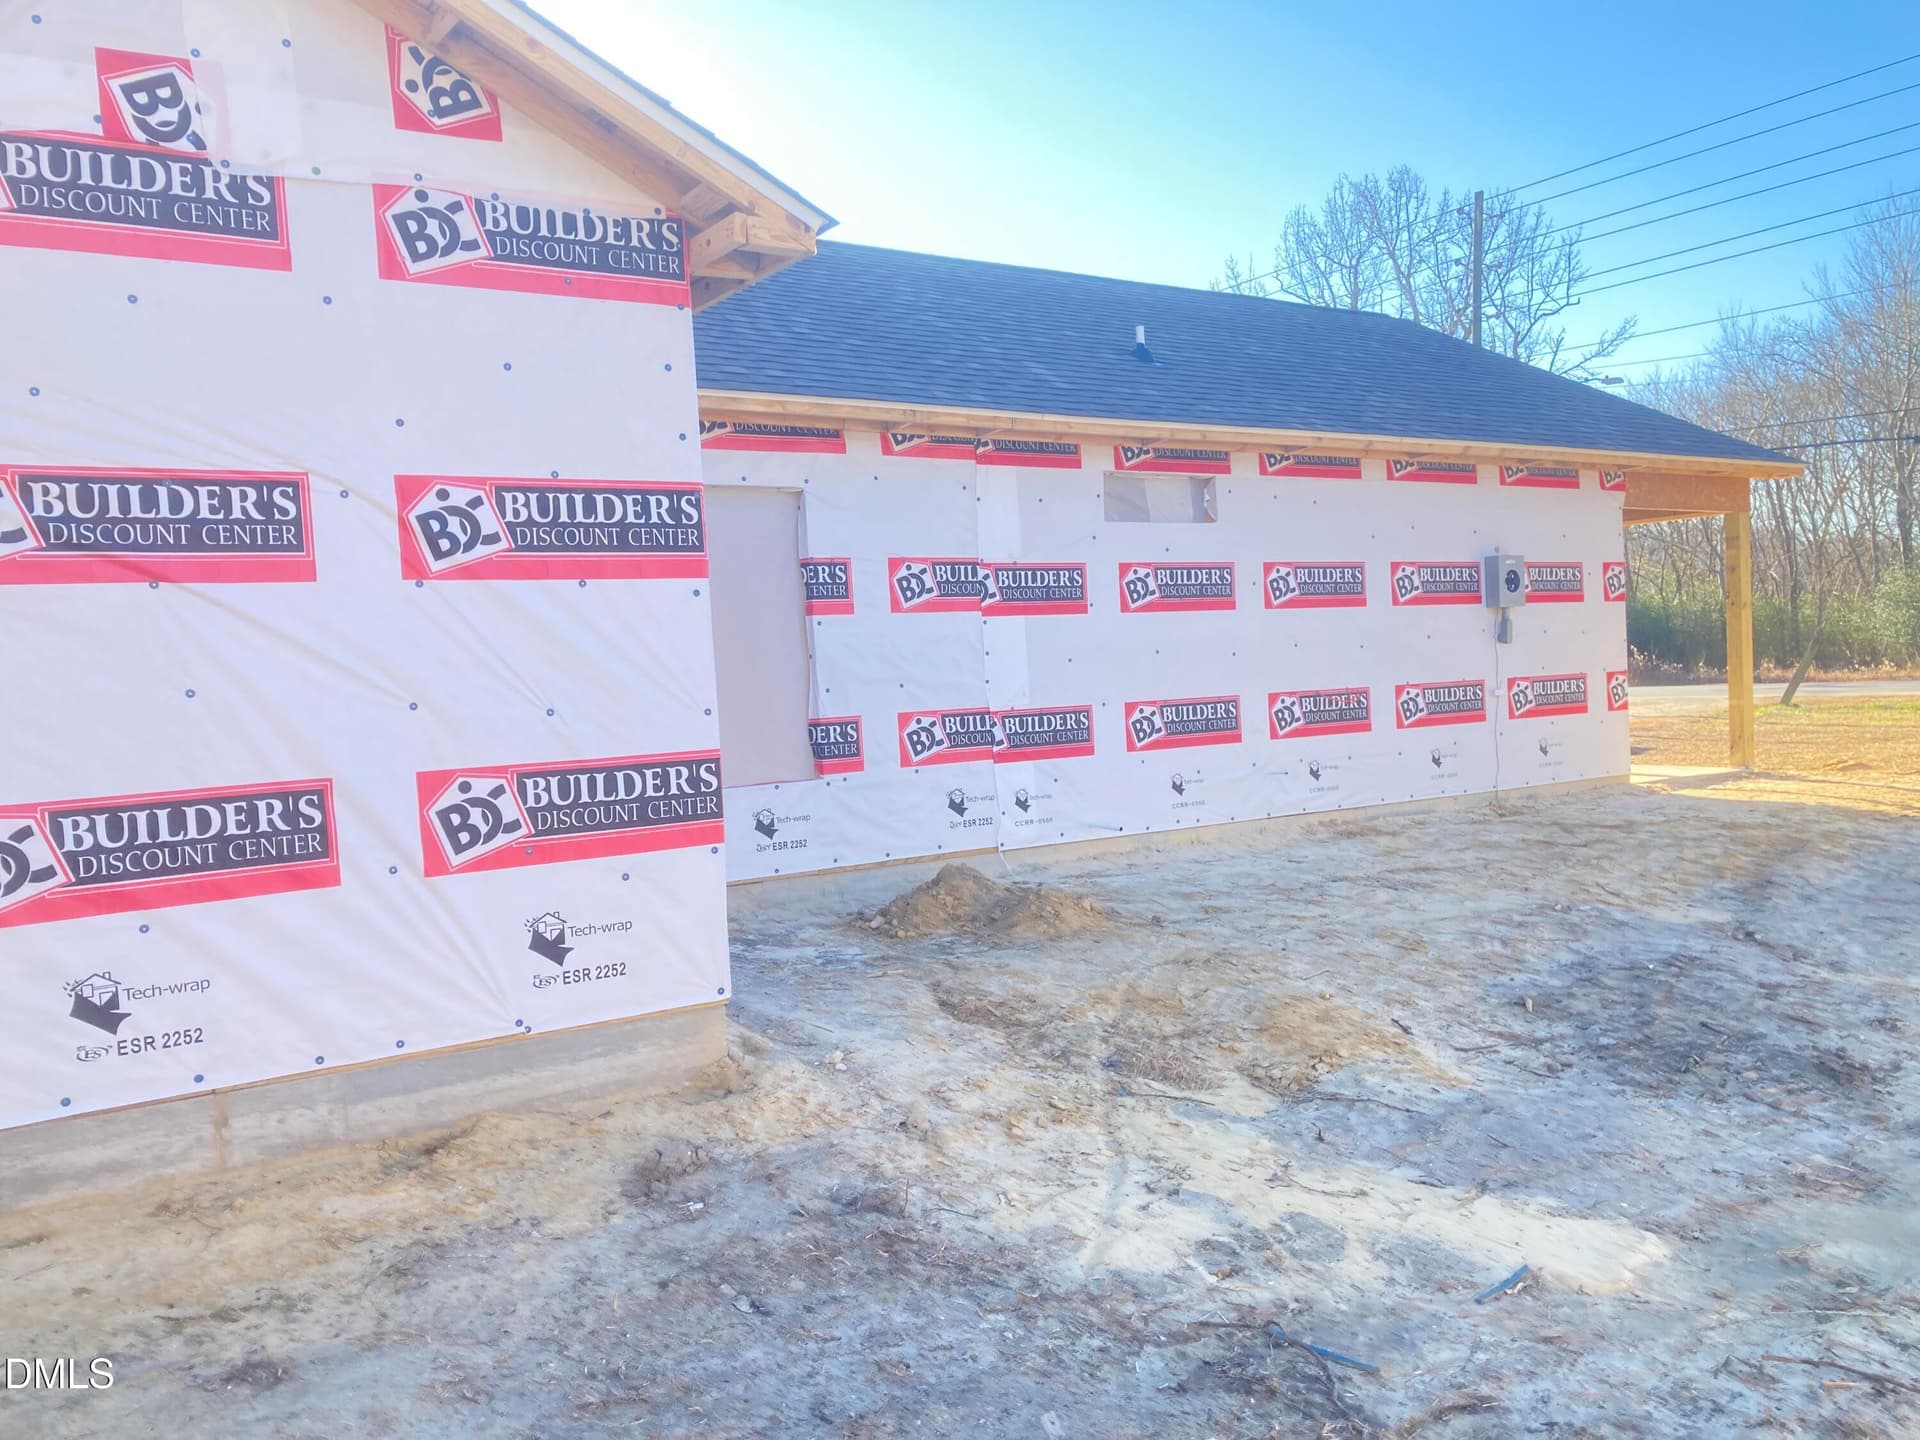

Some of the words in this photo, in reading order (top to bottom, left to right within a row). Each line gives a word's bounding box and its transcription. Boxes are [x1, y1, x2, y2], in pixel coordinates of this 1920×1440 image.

[1, 141, 272, 206] BUILDER'S
[19, 184, 162, 220] DISCOUNT
[174, 202, 271, 232] CENTER
[483, 199, 681, 252] BUILDER'S
[496, 236, 600, 266] DISCOUNT
[608, 249, 680, 274] CENTER
[26, 481, 298, 521] BUILDER'S
[501, 491, 699, 525] BUILDER'S
[48, 522, 191, 545] DISCOUNT
[201, 523, 298, 545] CENTER
[516, 527, 620, 546] DISCOUNT
[628, 528, 700, 546] CENTER
[997, 570, 1082, 587] BUILDER'S
[1157, 568, 1232, 585] BUILDER'S
[1296, 567, 1362, 583] BUILDER'S
[1420, 567, 1478, 582] BUILDER'S
[1529, 567, 1581, 580] BUILDER'S
[1003, 588, 1046, 599] DISCOUNT
[1049, 588, 1082, 598] CENTER
[1161, 586, 1201, 596] DISCOUNT
[1203, 585, 1232, 595] CENTER
[1300, 583, 1336, 593] DISCOUNT
[1337, 583, 1362, 592] CENTER
[1424, 685, 1483, 702] BUILDER'S
[1533, 678, 1585, 695] BUILDER'S
[1162, 702, 1237, 722] BUILDER'S
[1301, 693, 1367, 712] BUILDER'S
[1004, 712, 1089, 733] BUILDER'S
[1305, 711, 1341, 722] DISCOUNT
[1342, 709, 1367, 719] CENTER
[1167, 721, 1206, 733] DISCOUNT
[1208, 719, 1237, 730] CENTER
[1010, 733, 1054, 746] DISCOUNT
[1057, 730, 1089, 741] CENTER
[522, 762, 719, 809] BUILDER'S
[536, 804, 641, 831] DISCOUNT
[648, 796, 719, 818] CENTER
[57, 795, 323, 852] BUILDER'S
[772, 841, 789, 851] ESR
[790, 839, 808, 849] 2252
[77, 844, 218, 878] DISCOUNT
[228, 833, 323, 861] CENTER
[567, 920, 633, 939] Tech-wrap
[562, 967, 592, 985] ESR
[595, 962, 627, 980] 2252
[122, 978, 211, 1002] Tech-wrap
[117, 1035, 157, 1057] ESR
[162, 1027, 204, 1049] 2252
